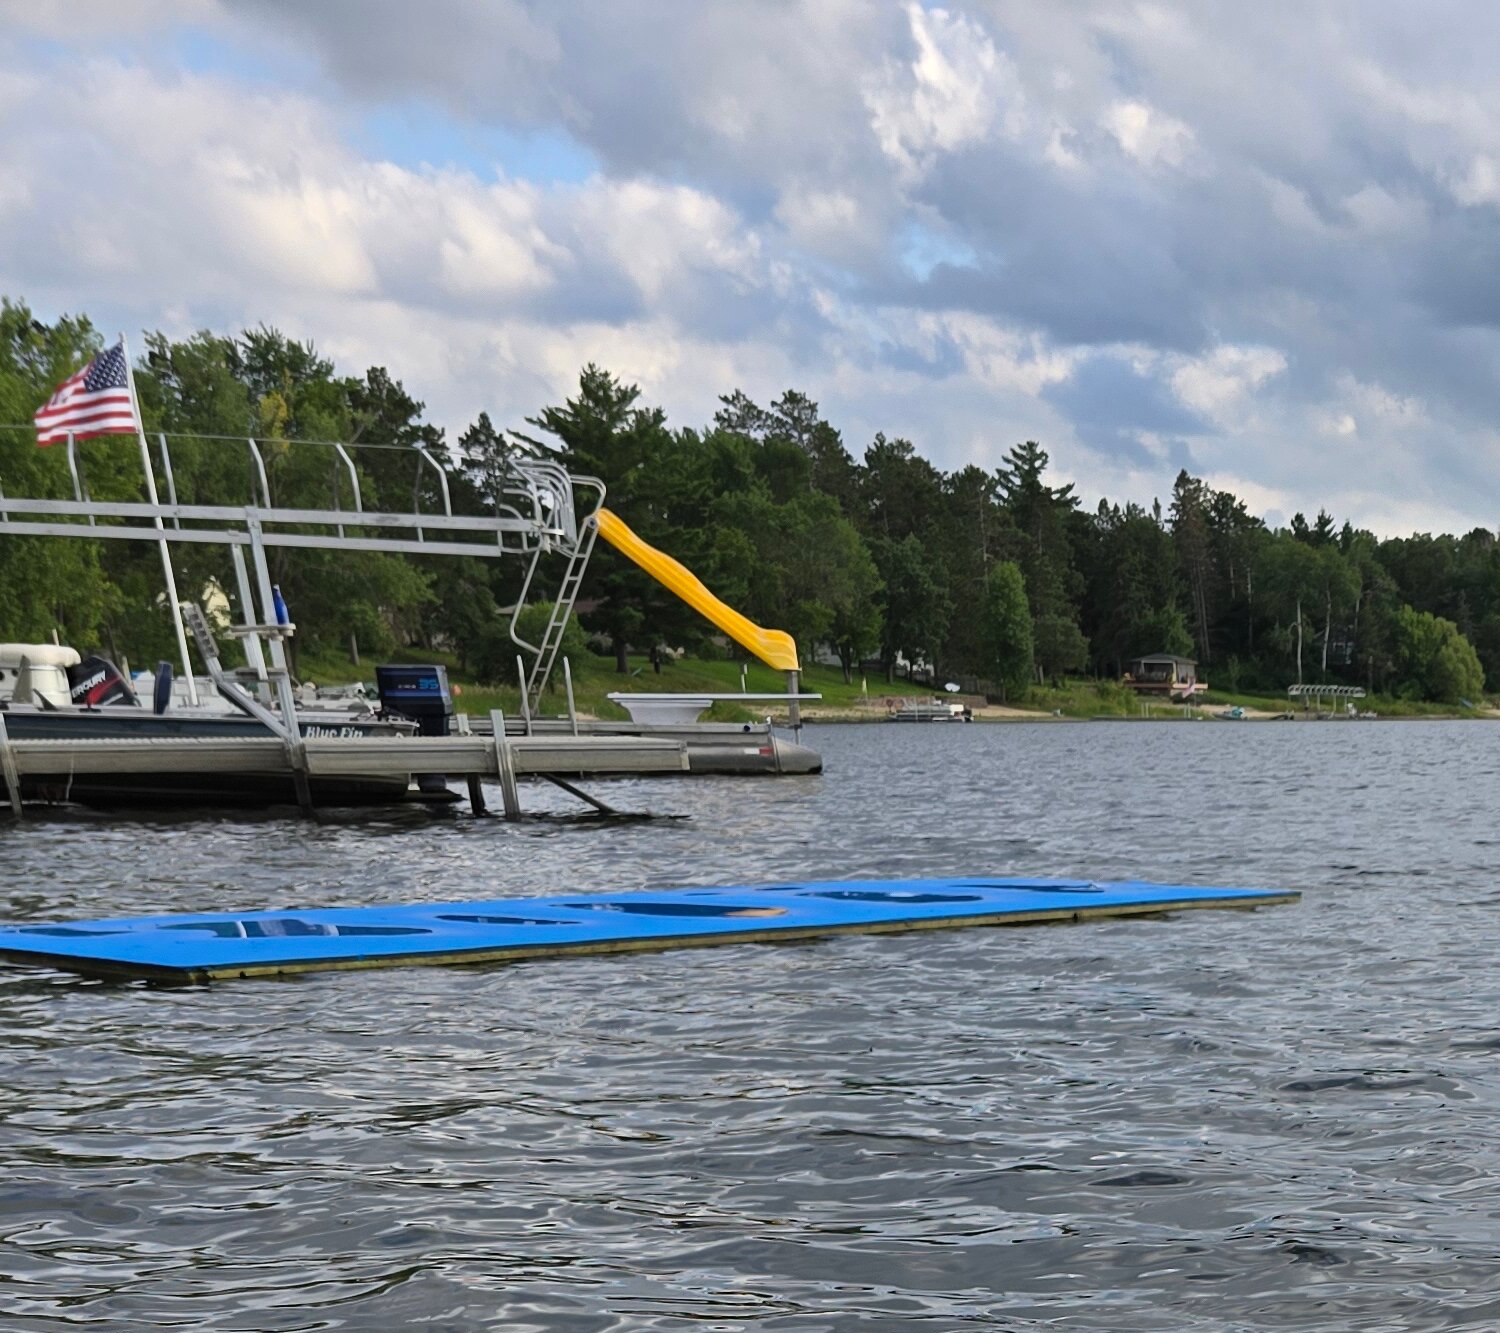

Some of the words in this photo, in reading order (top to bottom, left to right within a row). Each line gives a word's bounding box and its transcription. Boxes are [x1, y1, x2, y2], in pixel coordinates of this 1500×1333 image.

[71, 669, 106, 698] ERCURY
[305, 725, 338, 739] Blue
[339, 726, 364, 739] Fin
